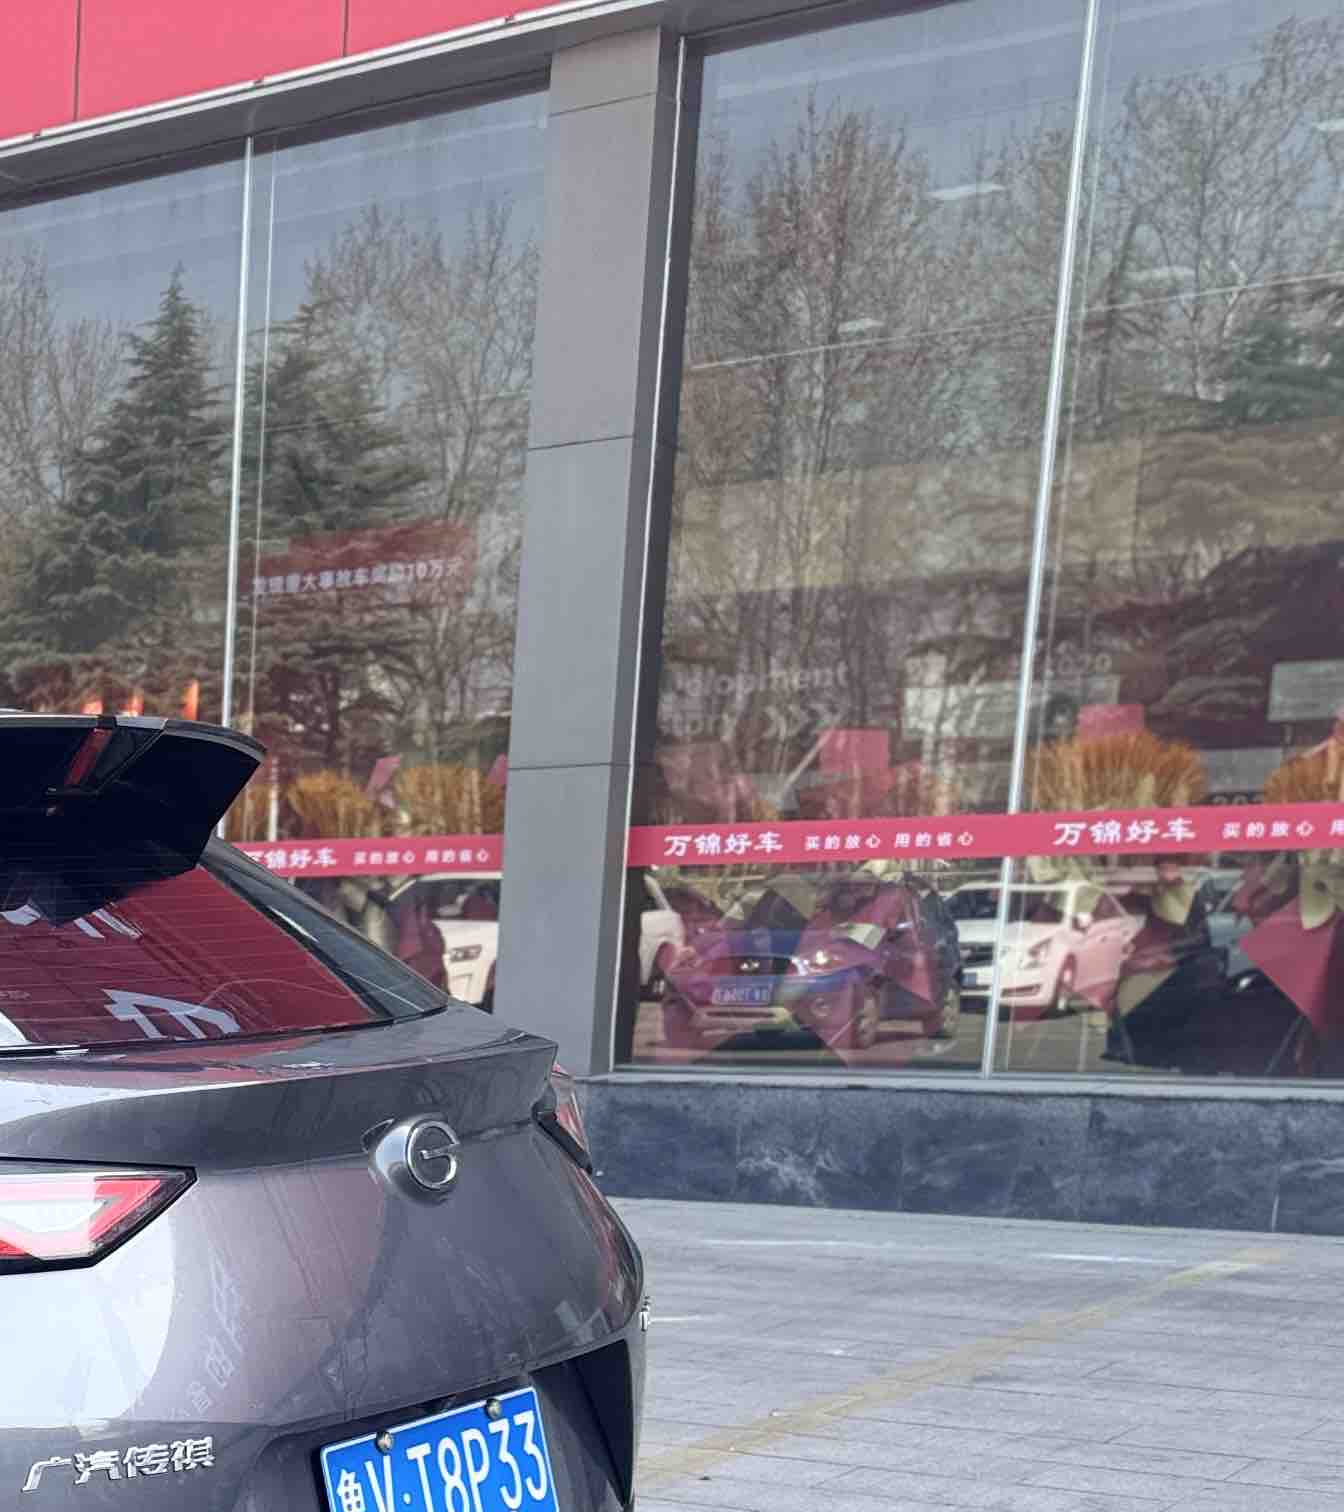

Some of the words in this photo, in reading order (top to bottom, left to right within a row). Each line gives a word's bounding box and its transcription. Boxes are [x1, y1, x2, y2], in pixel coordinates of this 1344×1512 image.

[663, 831, 784, 857] 万锦好车
[804, 833, 881, 850] 买的放心
[894, 831, 975, 848] 用的省心
[1052, 817, 1196, 846] 万锦好车
[1221, 819, 1315, 839] 买的放心
[353, 849, 416, 865] 买的放心
[424, 848, 491, 864] 用的省心
[21, 1436, 217, 1493] 广汽传祺
